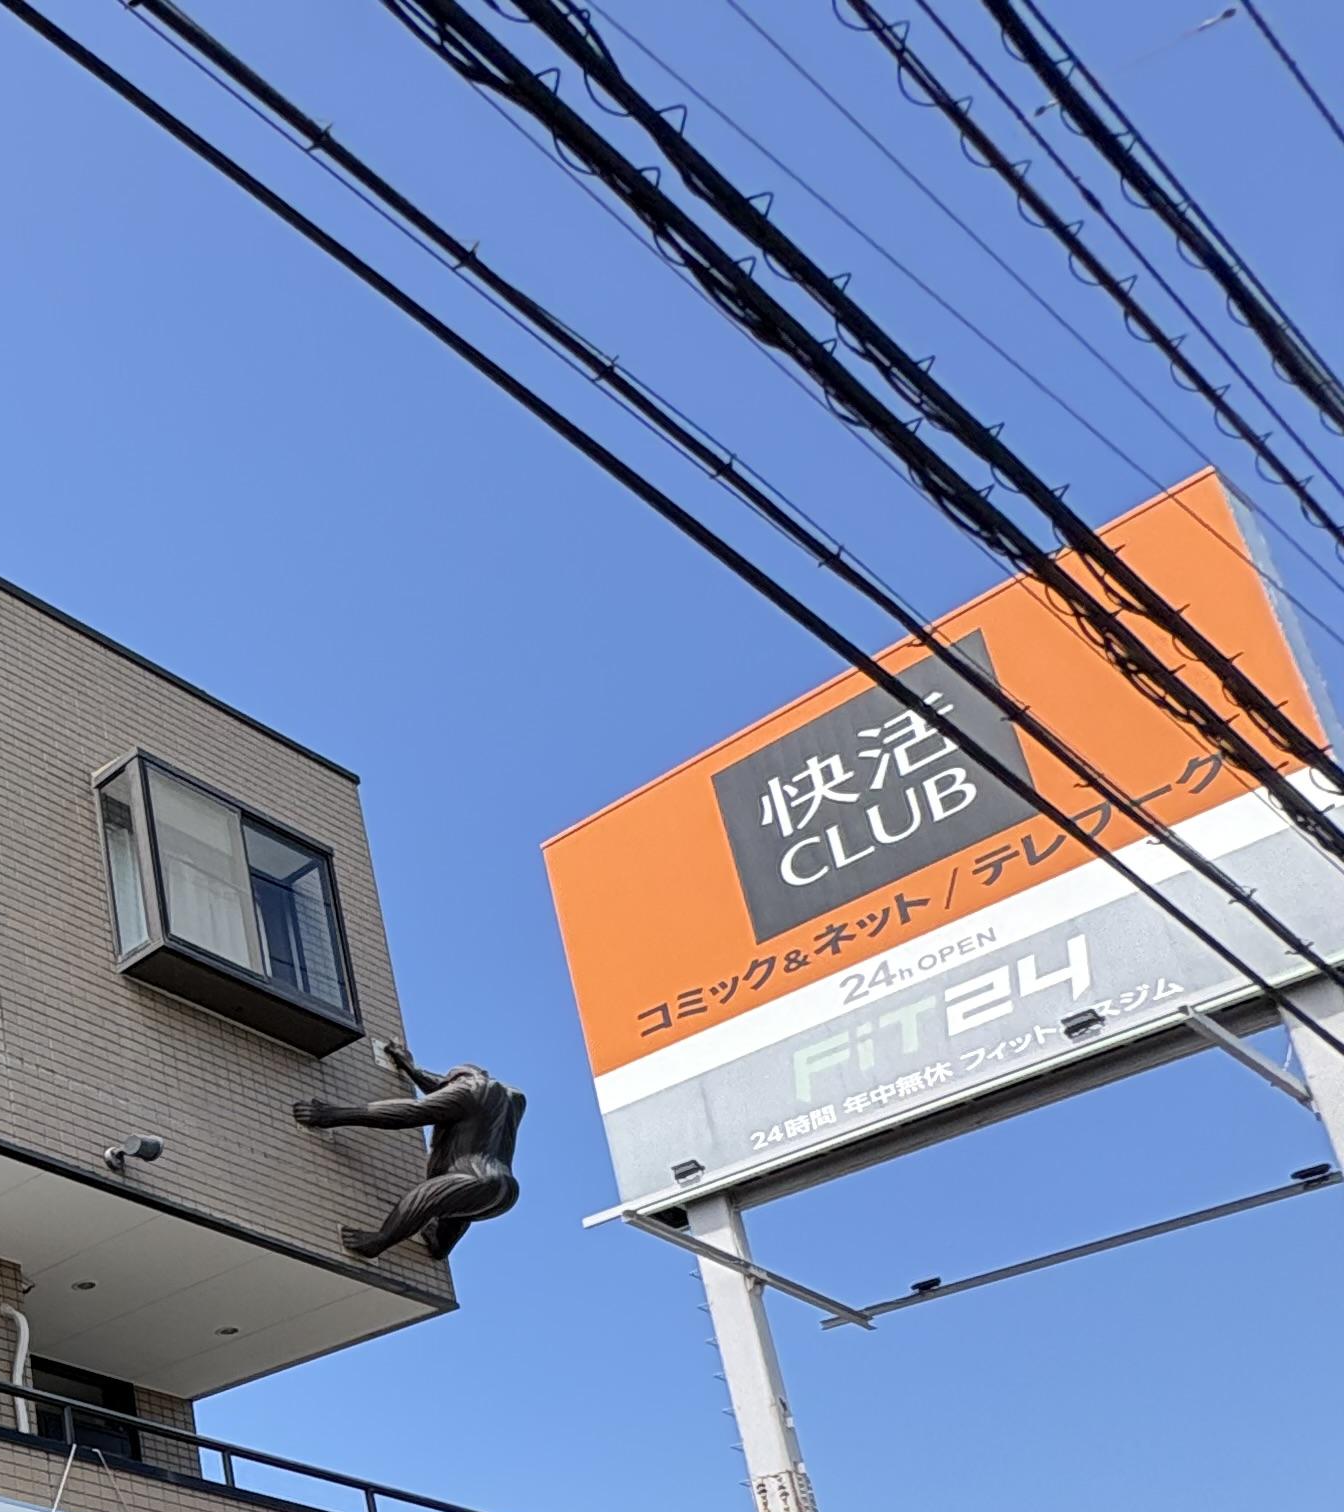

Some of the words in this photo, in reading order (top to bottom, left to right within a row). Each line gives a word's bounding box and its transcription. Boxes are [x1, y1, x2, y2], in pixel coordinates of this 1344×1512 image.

[761, 691, 959, 837] 快活
[779, 767, 977, 886] CLUB
[917, 926, 997, 971] OPEN
[750, 1102, 837, 1150] 24時間
[842, 1061, 953, 1114] 年中無休
[960, 977, 1185, 1071] フィットスジム
